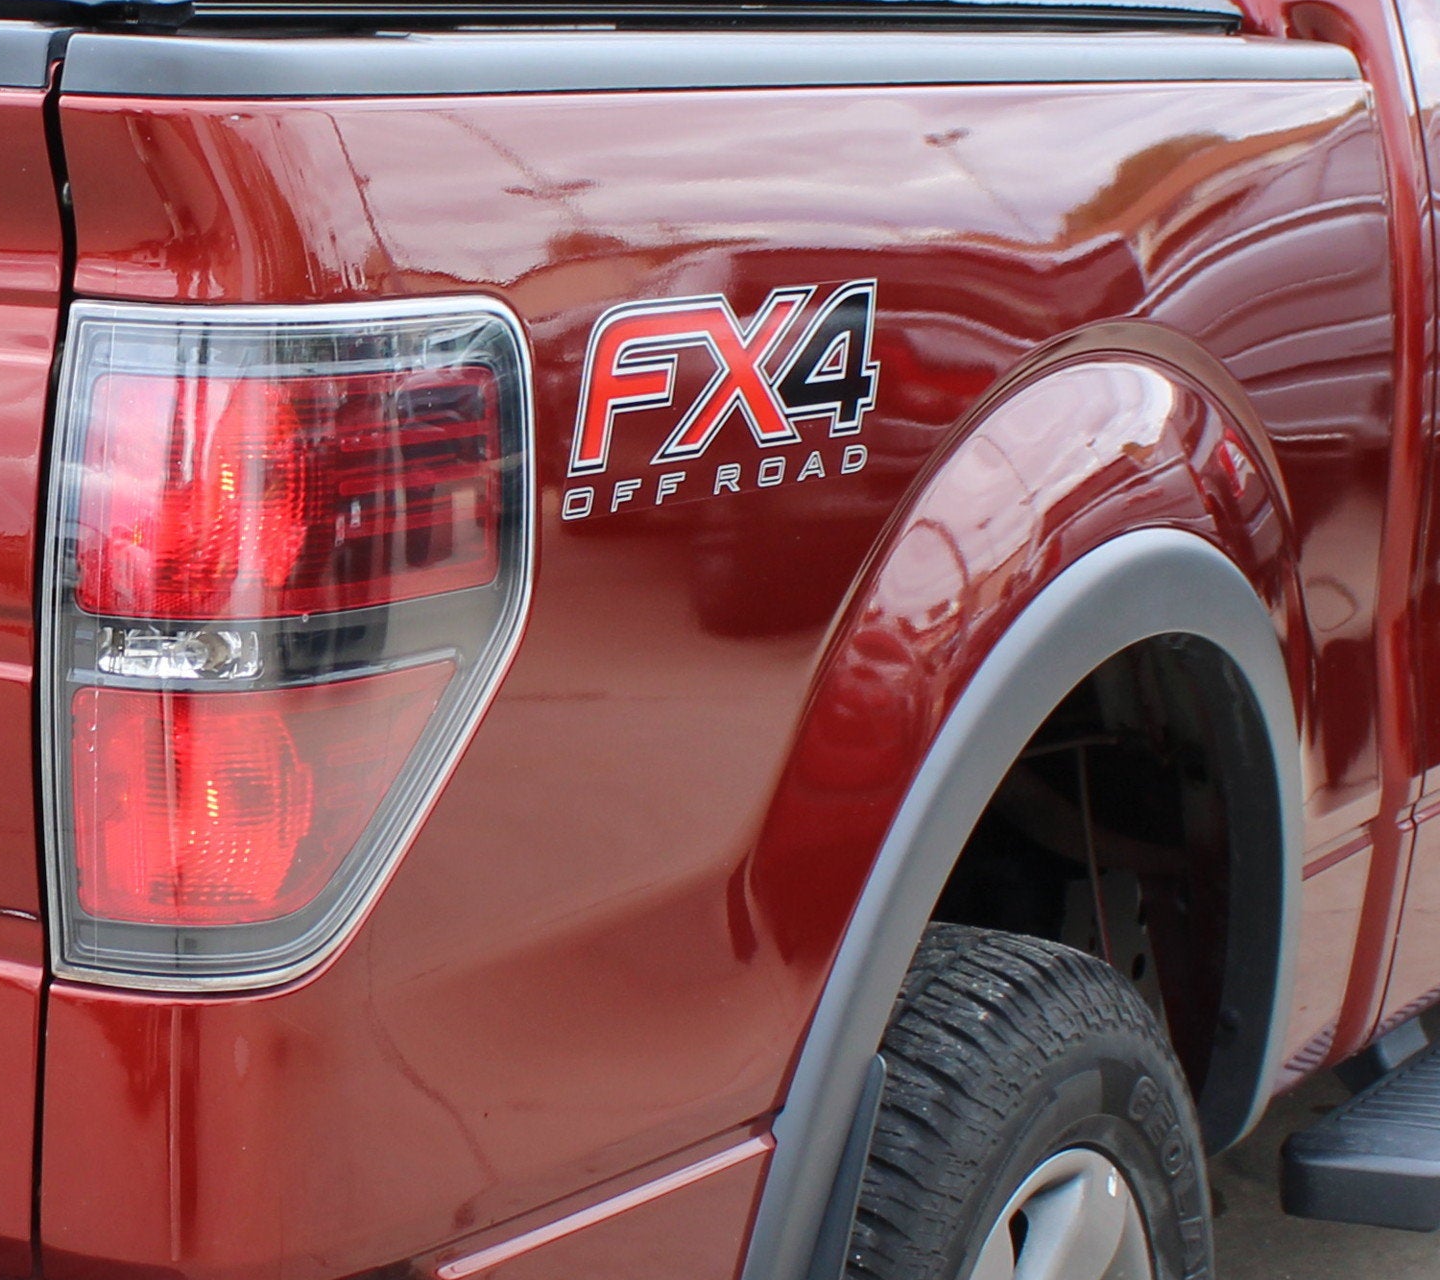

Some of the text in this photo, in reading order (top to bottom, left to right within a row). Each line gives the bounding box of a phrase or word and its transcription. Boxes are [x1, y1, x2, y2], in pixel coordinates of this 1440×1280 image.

[566, 277, 881, 479] FX4
[561, 443, 869, 521] OFF ROAD
